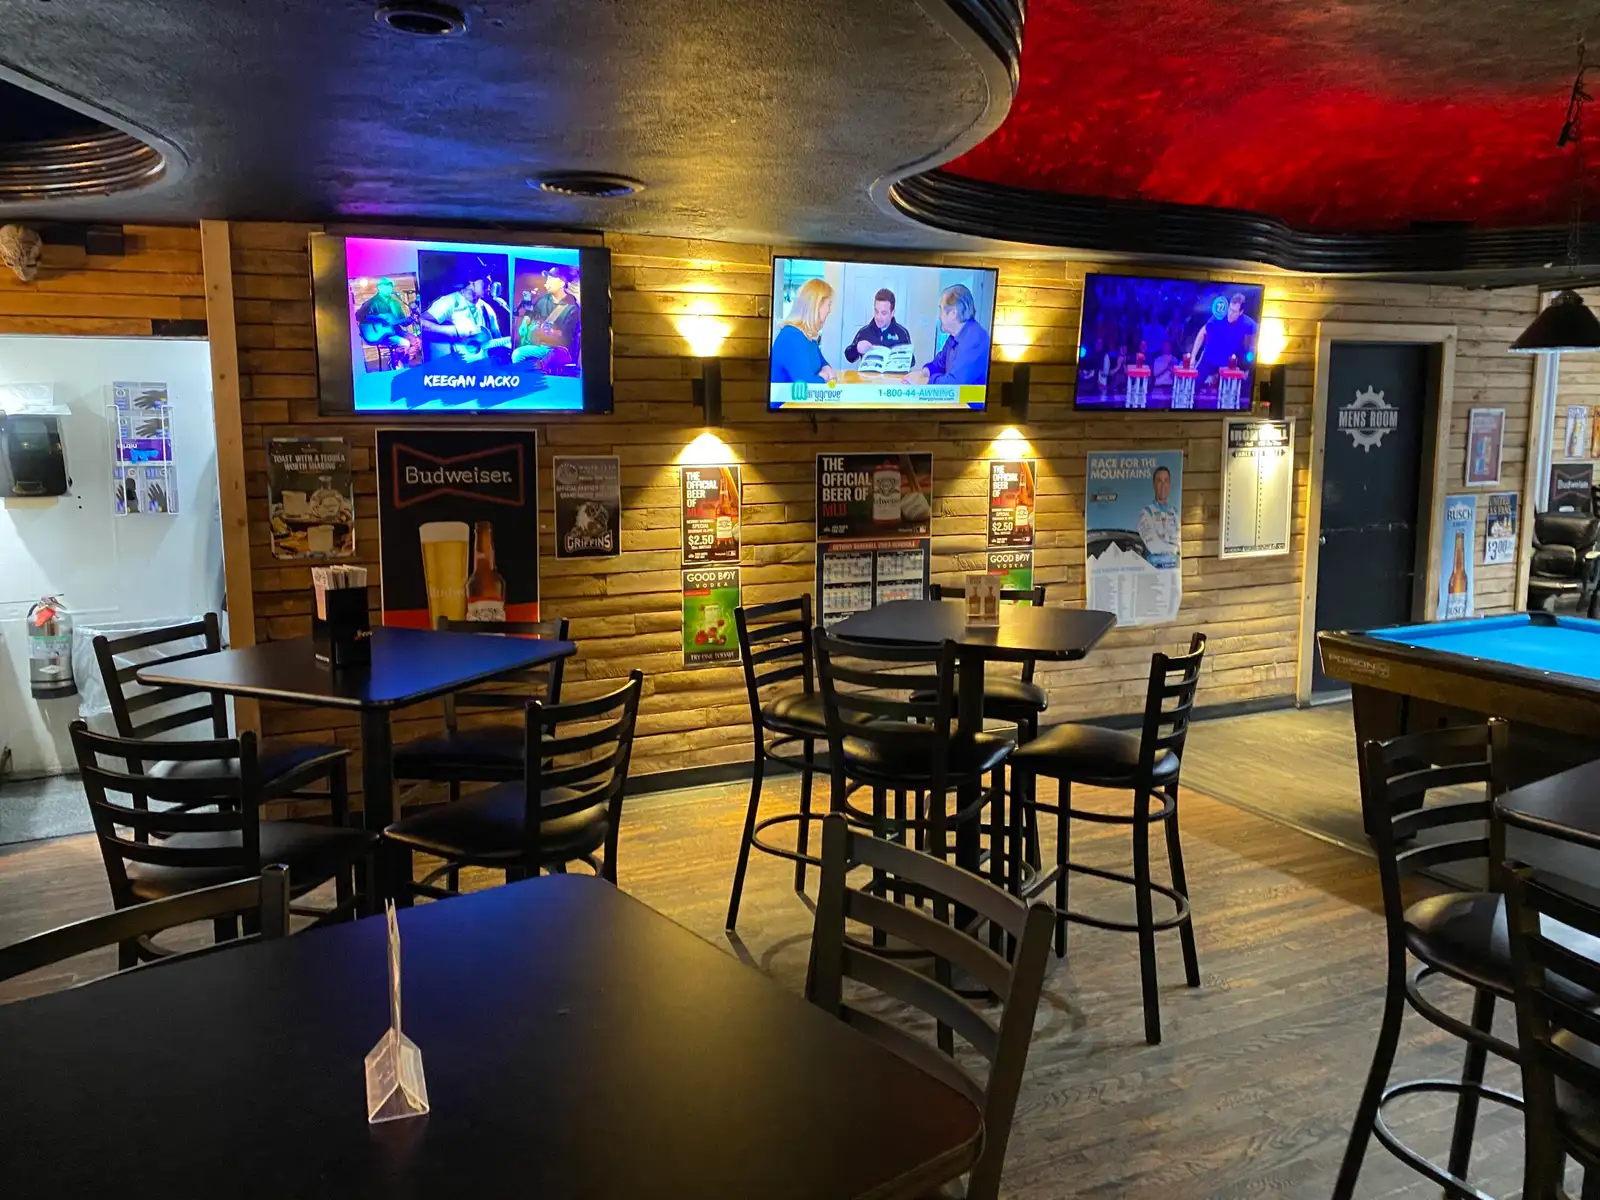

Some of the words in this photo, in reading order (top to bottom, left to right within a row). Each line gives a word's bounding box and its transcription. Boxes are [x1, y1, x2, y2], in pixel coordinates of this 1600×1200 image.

[424, 375, 476, 388] KEEGAN
[479, 375, 520, 388] JACKO
[878, 389, 955, 398] 1-800-44-AWNING
[1339, 411, 1366, 428] MENS
[1370, 411, 1398, 428] ROOM
[822, 457, 844, 471] THE
[1091, 458, 1117, 468] RACE
[1120, 458, 1139, 468] FOR
[1140, 457, 1157, 468] THE
[992, 465, 1005, 474] THE
[1090, 469, 1152, 479] MOUNTAINS
[686, 471, 700, 481] THE
[822, 472, 872, 487] OFFICIAL
[686, 480, 718, 489] OFFICIAL
[992, 481, 1008, 490] BEER
[687, 489, 706, 499] BEER
[822, 487, 852, 502] BEER
[854, 487, 869, 501] OF
[992, 490, 1000, 498] OF
[687, 498, 697, 508] OF
[1448, 507, 1473, 521] BUSCH
[992, 521, 1013, 532] $2.50
[567, 534, 611, 549] GRIFFINS
[688, 534, 714, 546] $2.50
[990, 554, 1014, 563] GOOD
[1015, 553, 1030, 562] BOY
[687, 572, 716, 582] GOOD
[718, 571, 736, 580] BOY
